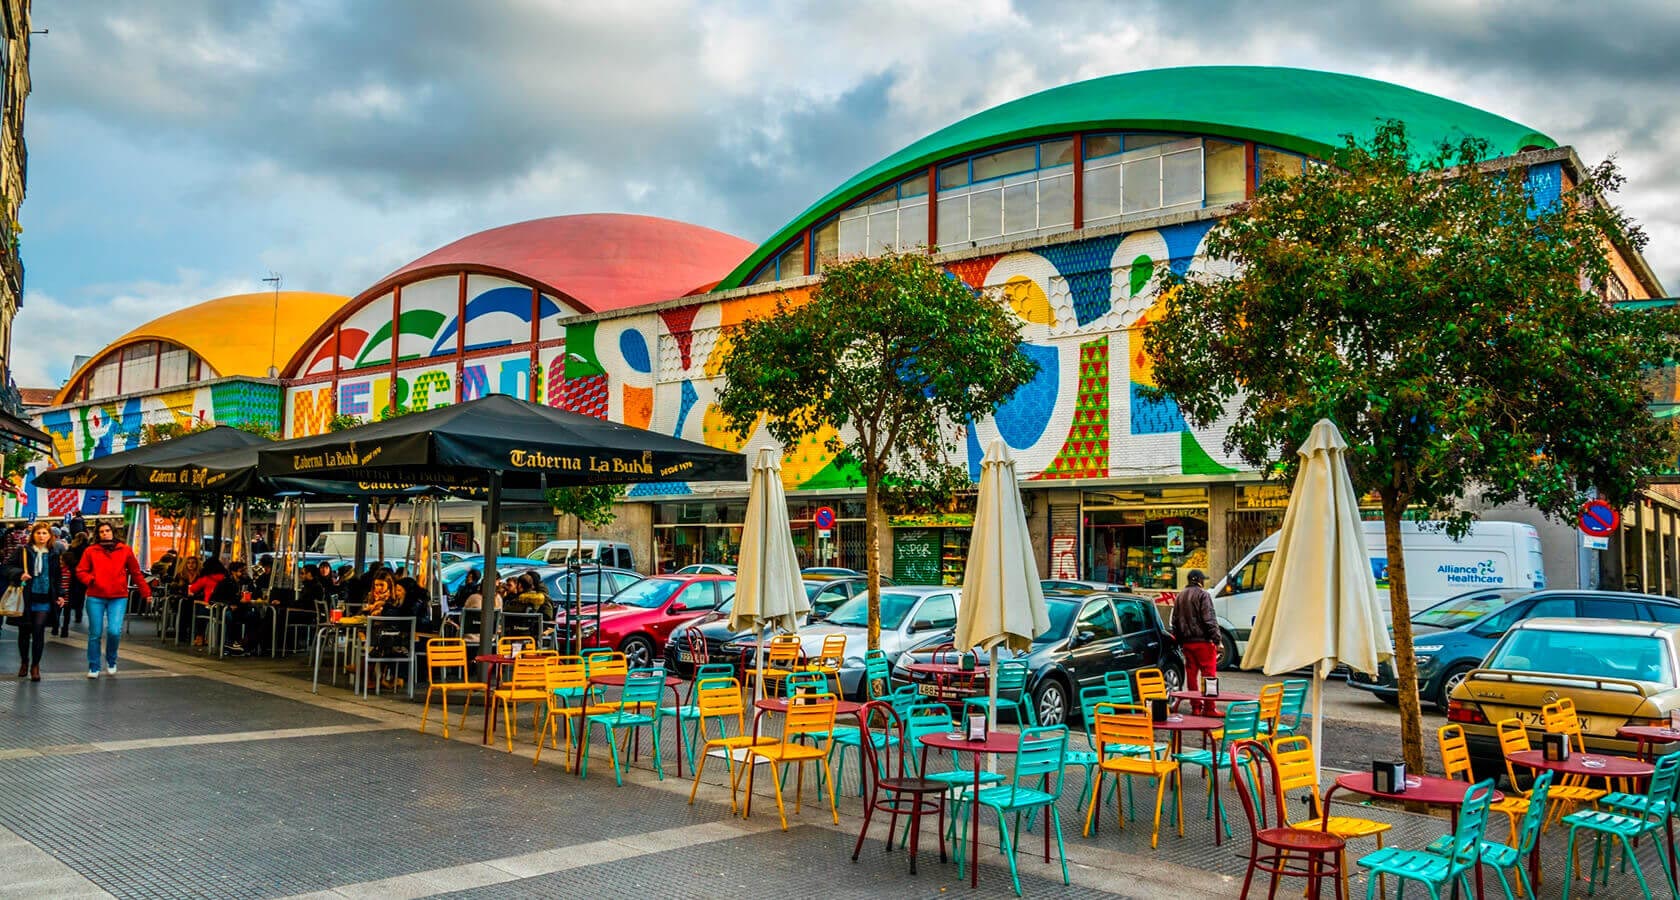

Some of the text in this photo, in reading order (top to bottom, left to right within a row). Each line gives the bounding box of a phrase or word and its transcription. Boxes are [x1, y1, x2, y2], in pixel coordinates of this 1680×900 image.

[325, 453, 336, 466] La
[510, 449, 582, 470] Taberna
[589, 456, 610, 472] La
[1437, 565, 1478, 574] Alliance
[1447, 574, 1504, 584] Healthcare
